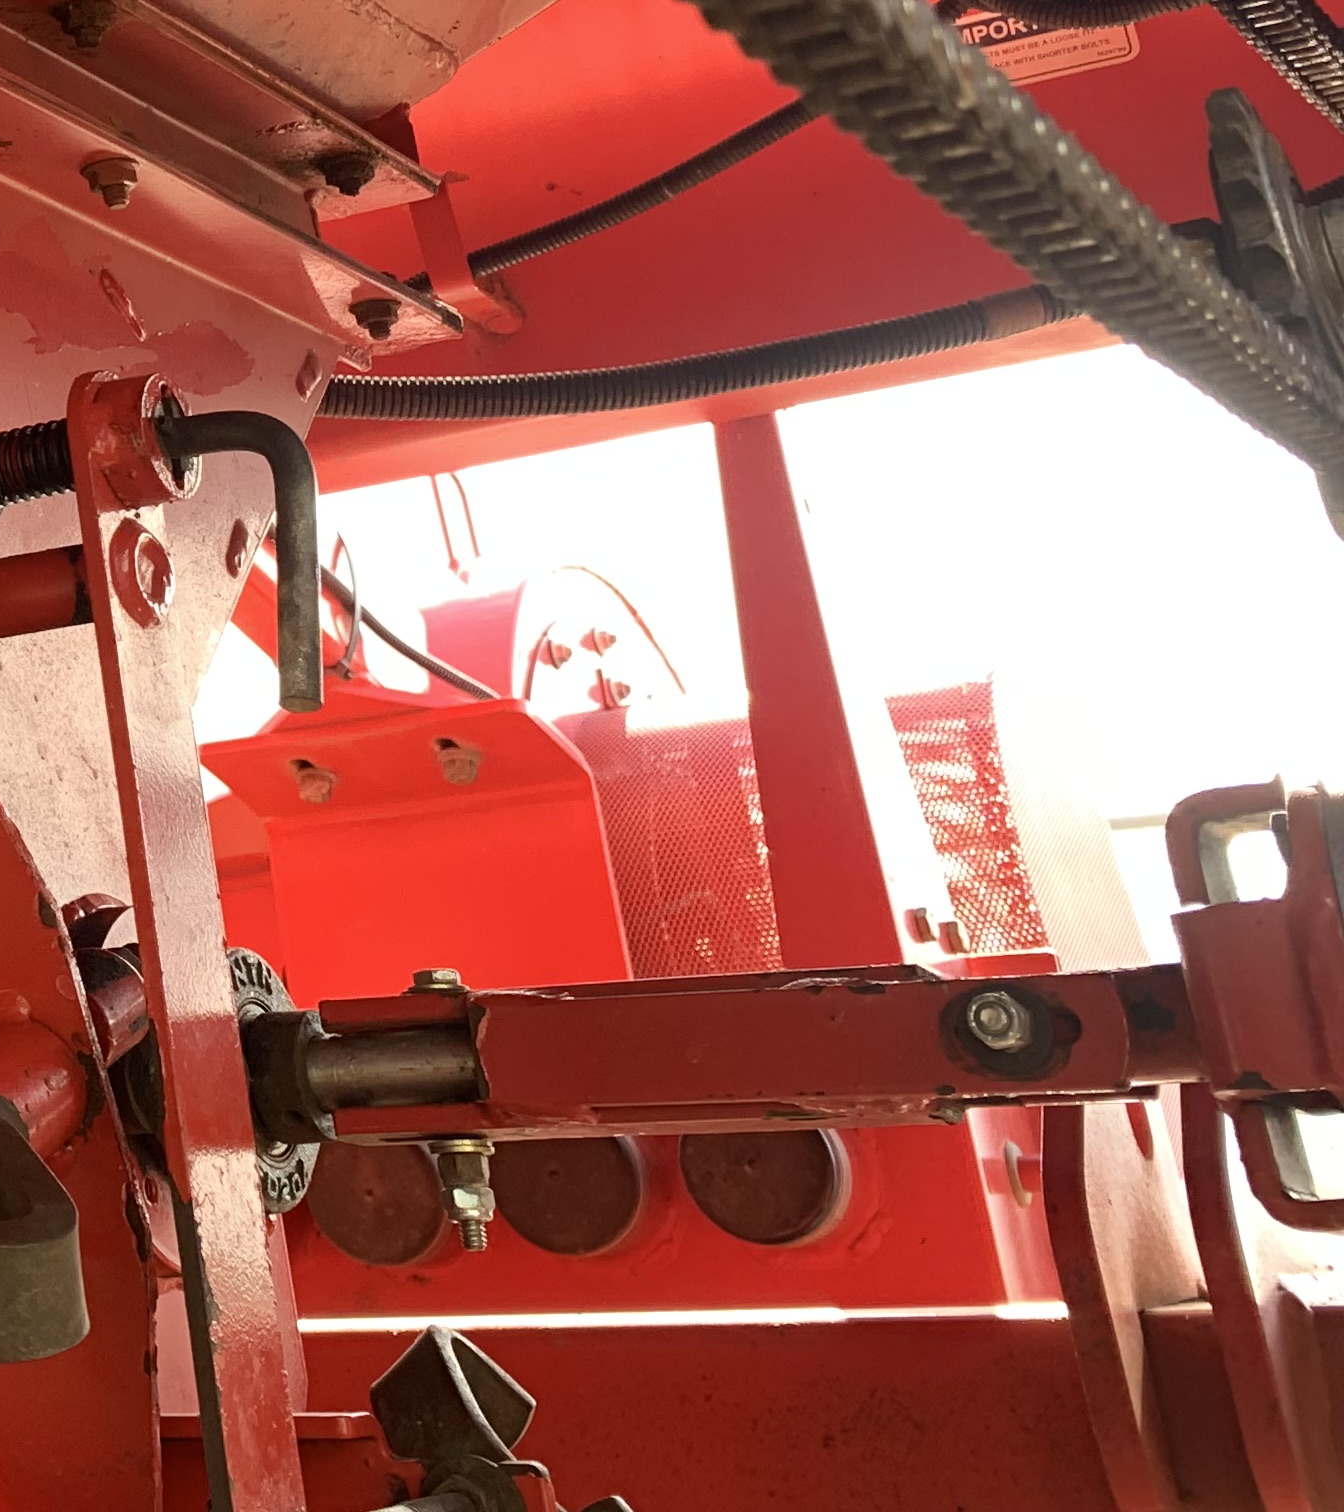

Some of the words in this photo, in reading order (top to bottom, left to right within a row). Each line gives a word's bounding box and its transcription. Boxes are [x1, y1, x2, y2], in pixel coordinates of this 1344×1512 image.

[1014, 55, 1036, 66] WITH
[1037, 45, 1079, 61] SHORTER
[1080, 38, 1110, 51] BOLTS
[1027, 41, 1040, 50] BE
[1042, 39, 1048, 47] A
[1050, 33, 1080, 44] LOOSE
